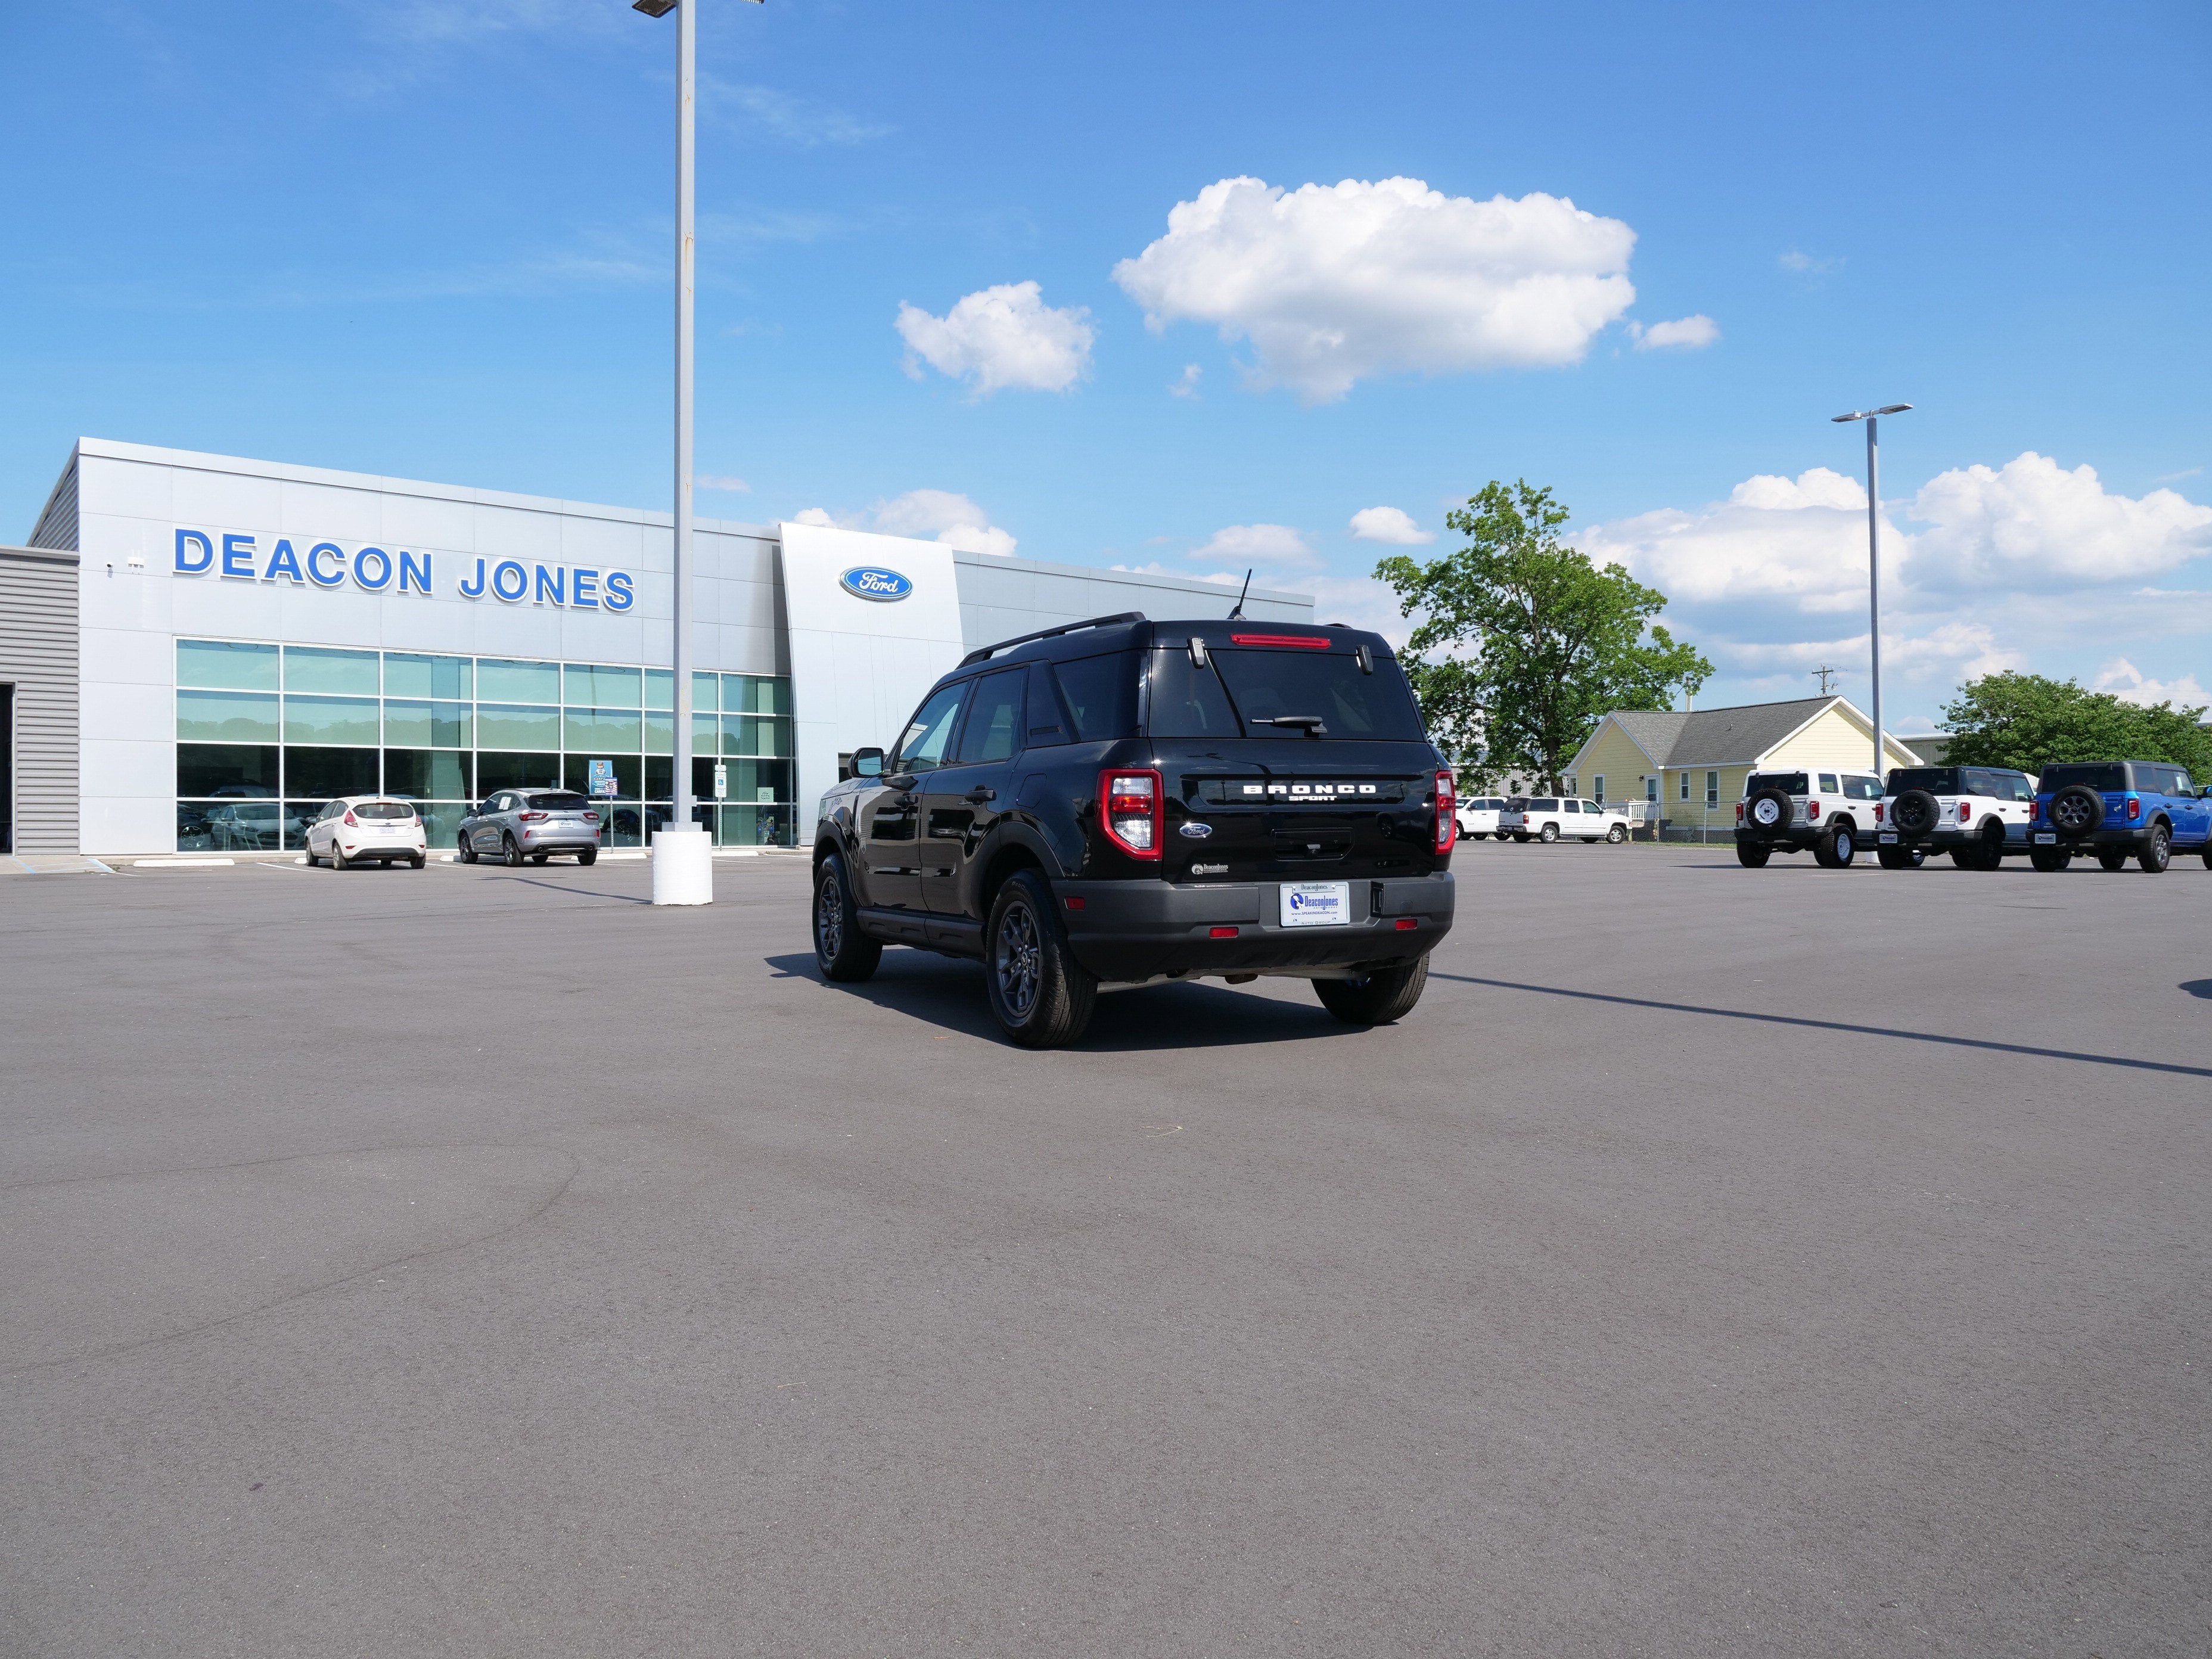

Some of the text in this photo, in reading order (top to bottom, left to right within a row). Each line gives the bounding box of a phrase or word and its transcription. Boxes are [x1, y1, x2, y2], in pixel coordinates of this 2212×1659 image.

[173, 527, 635, 612] DEACON JONES
[859, 571, 899, 593] Ford
[1243, 785, 1377, 794] BRONCO
[1187, 826, 1205, 834] Ford
[1304, 895, 1338, 911] DeaconJones
